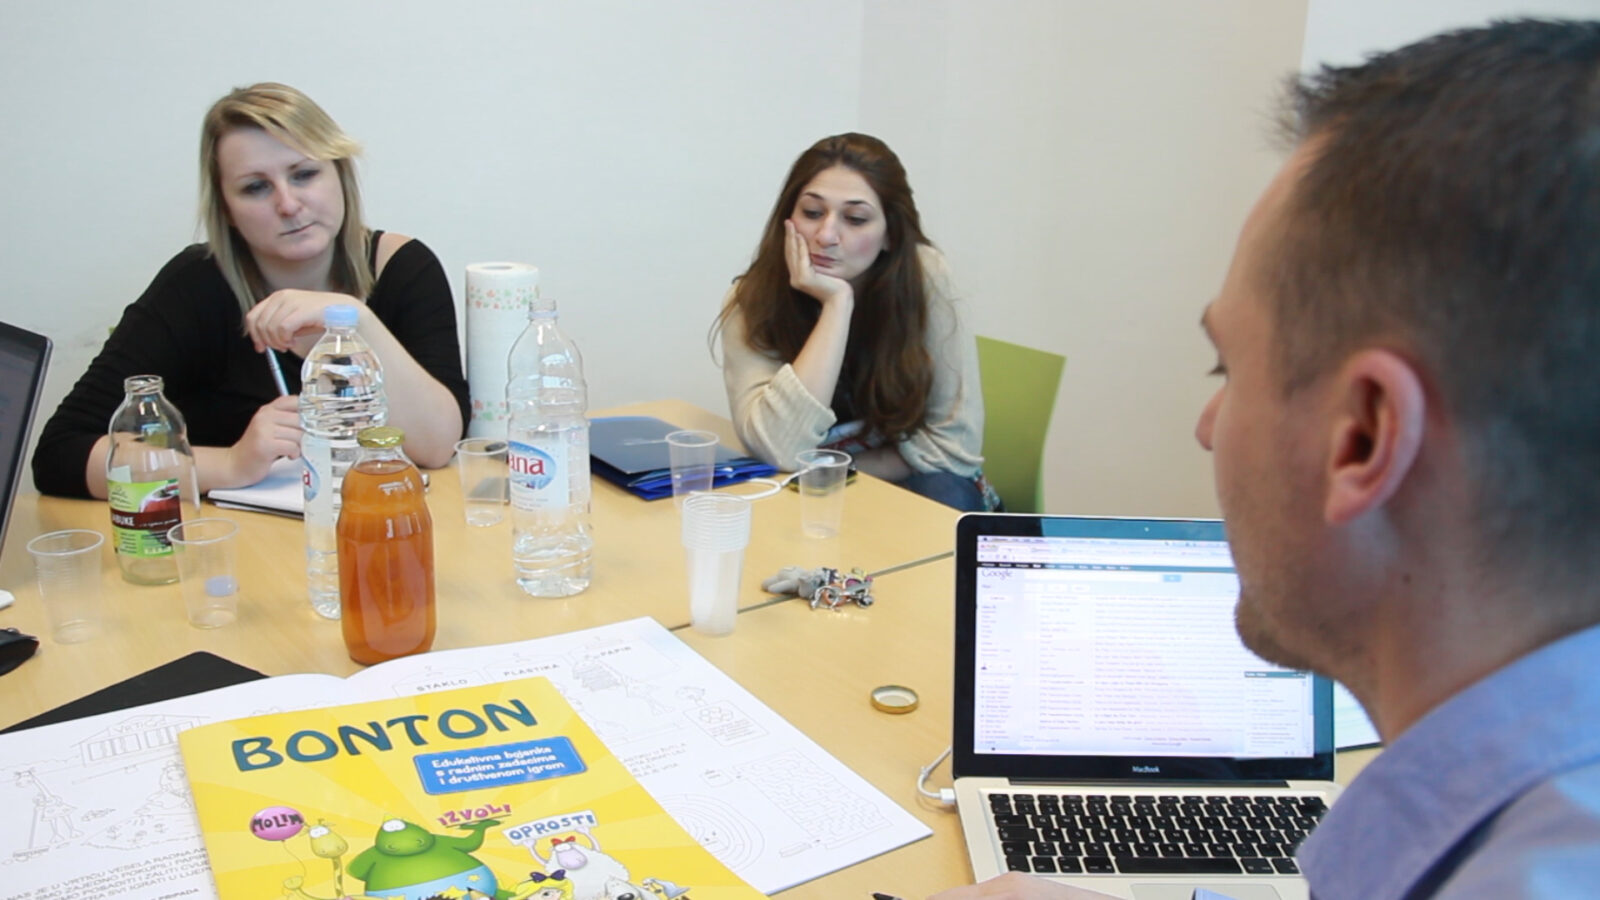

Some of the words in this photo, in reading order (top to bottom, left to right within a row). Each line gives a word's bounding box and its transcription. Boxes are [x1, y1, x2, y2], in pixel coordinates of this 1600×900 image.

[503, 663, 560, 676] PLASTIKA
[416, 679, 468, 692] STAKLO
[232, 699, 538, 772] BONTON
[431, 753, 502, 769] Edukativna
[504, 746, 552, 761] bojanka
[435, 769, 446, 778] s
[448, 763, 495, 776] radnim
[498, 754, 557, 769] zadacima
[448, 767, 525, 784] društvenom
[527, 761, 566, 775] igrom
[1132, 765, 1160, 774] MacBook
[252, 813, 304, 833] MOLIM
[437, 803, 512, 826] IZVOLI
[509, 814, 595, 840] OPROSTI
[158, 887, 200, 900] PRIPADA
